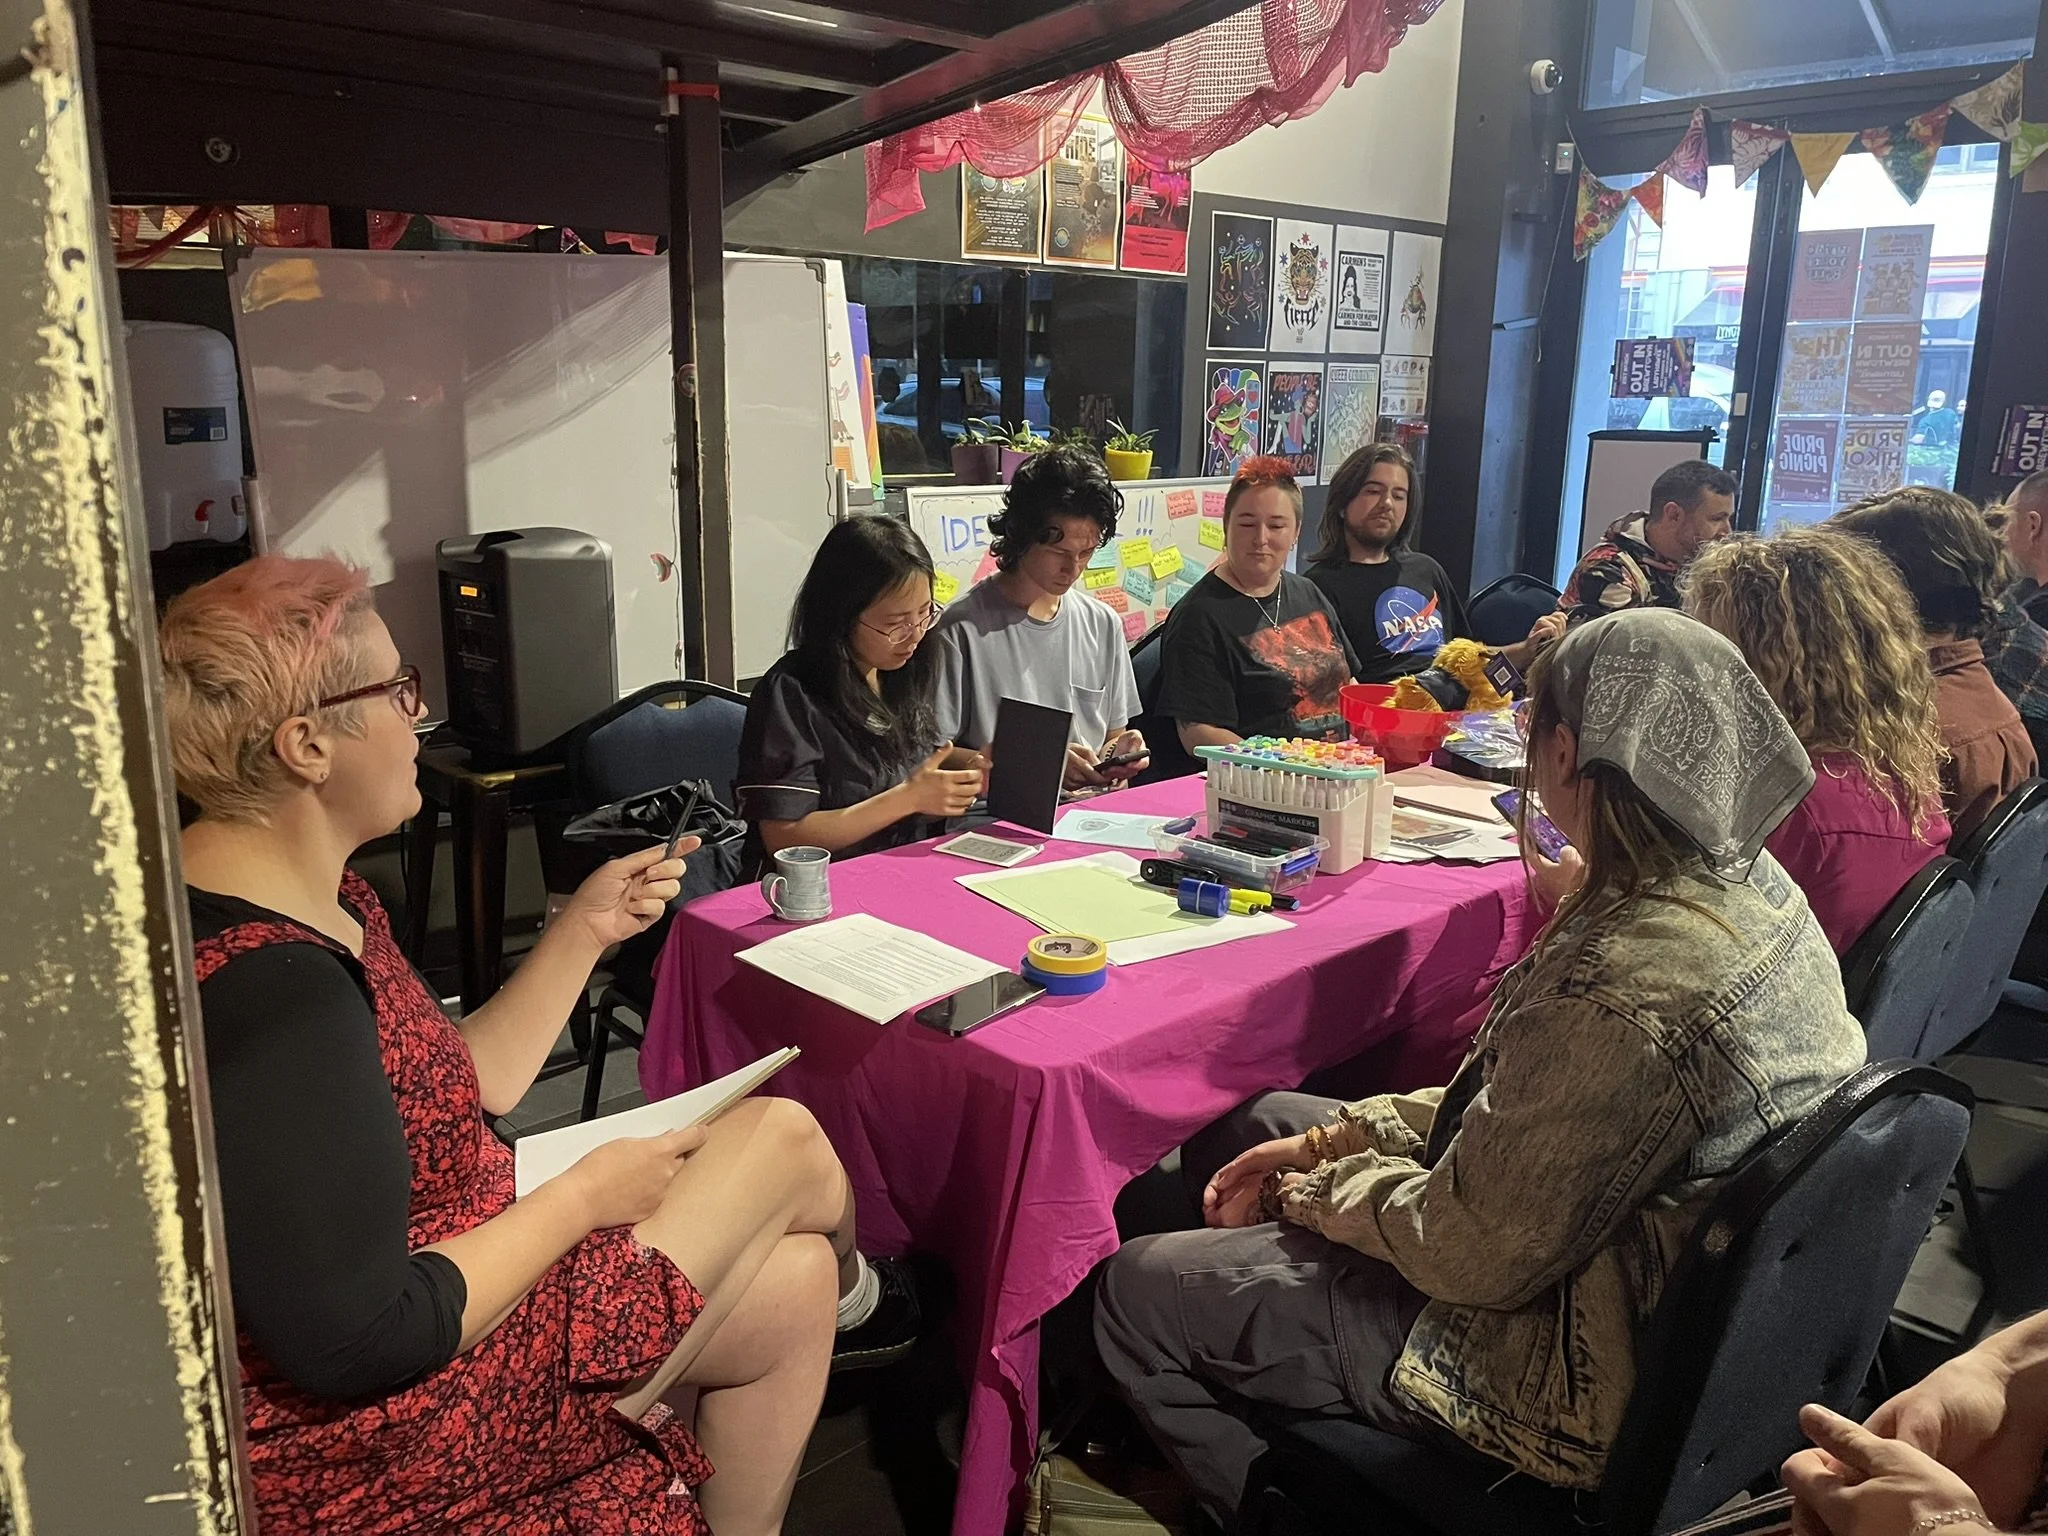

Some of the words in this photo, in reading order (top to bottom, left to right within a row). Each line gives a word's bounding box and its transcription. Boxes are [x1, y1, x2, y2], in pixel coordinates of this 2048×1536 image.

[1633, 344, 1646, 358] IN
[1630, 361, 1645, 393] OUT
[1642, 343, 1654, 392] BREWTOWN
[2026, 413, 2045, 429] IN
[2019, 432, 2040, 470] OUT
[941, 515, 989, 556] IDE
[1382, 615, 1443, 639] NASA
[1244, 808, 1277, 821] GRAPHIC
[1278, 815, 1316, 828] MARKERS
